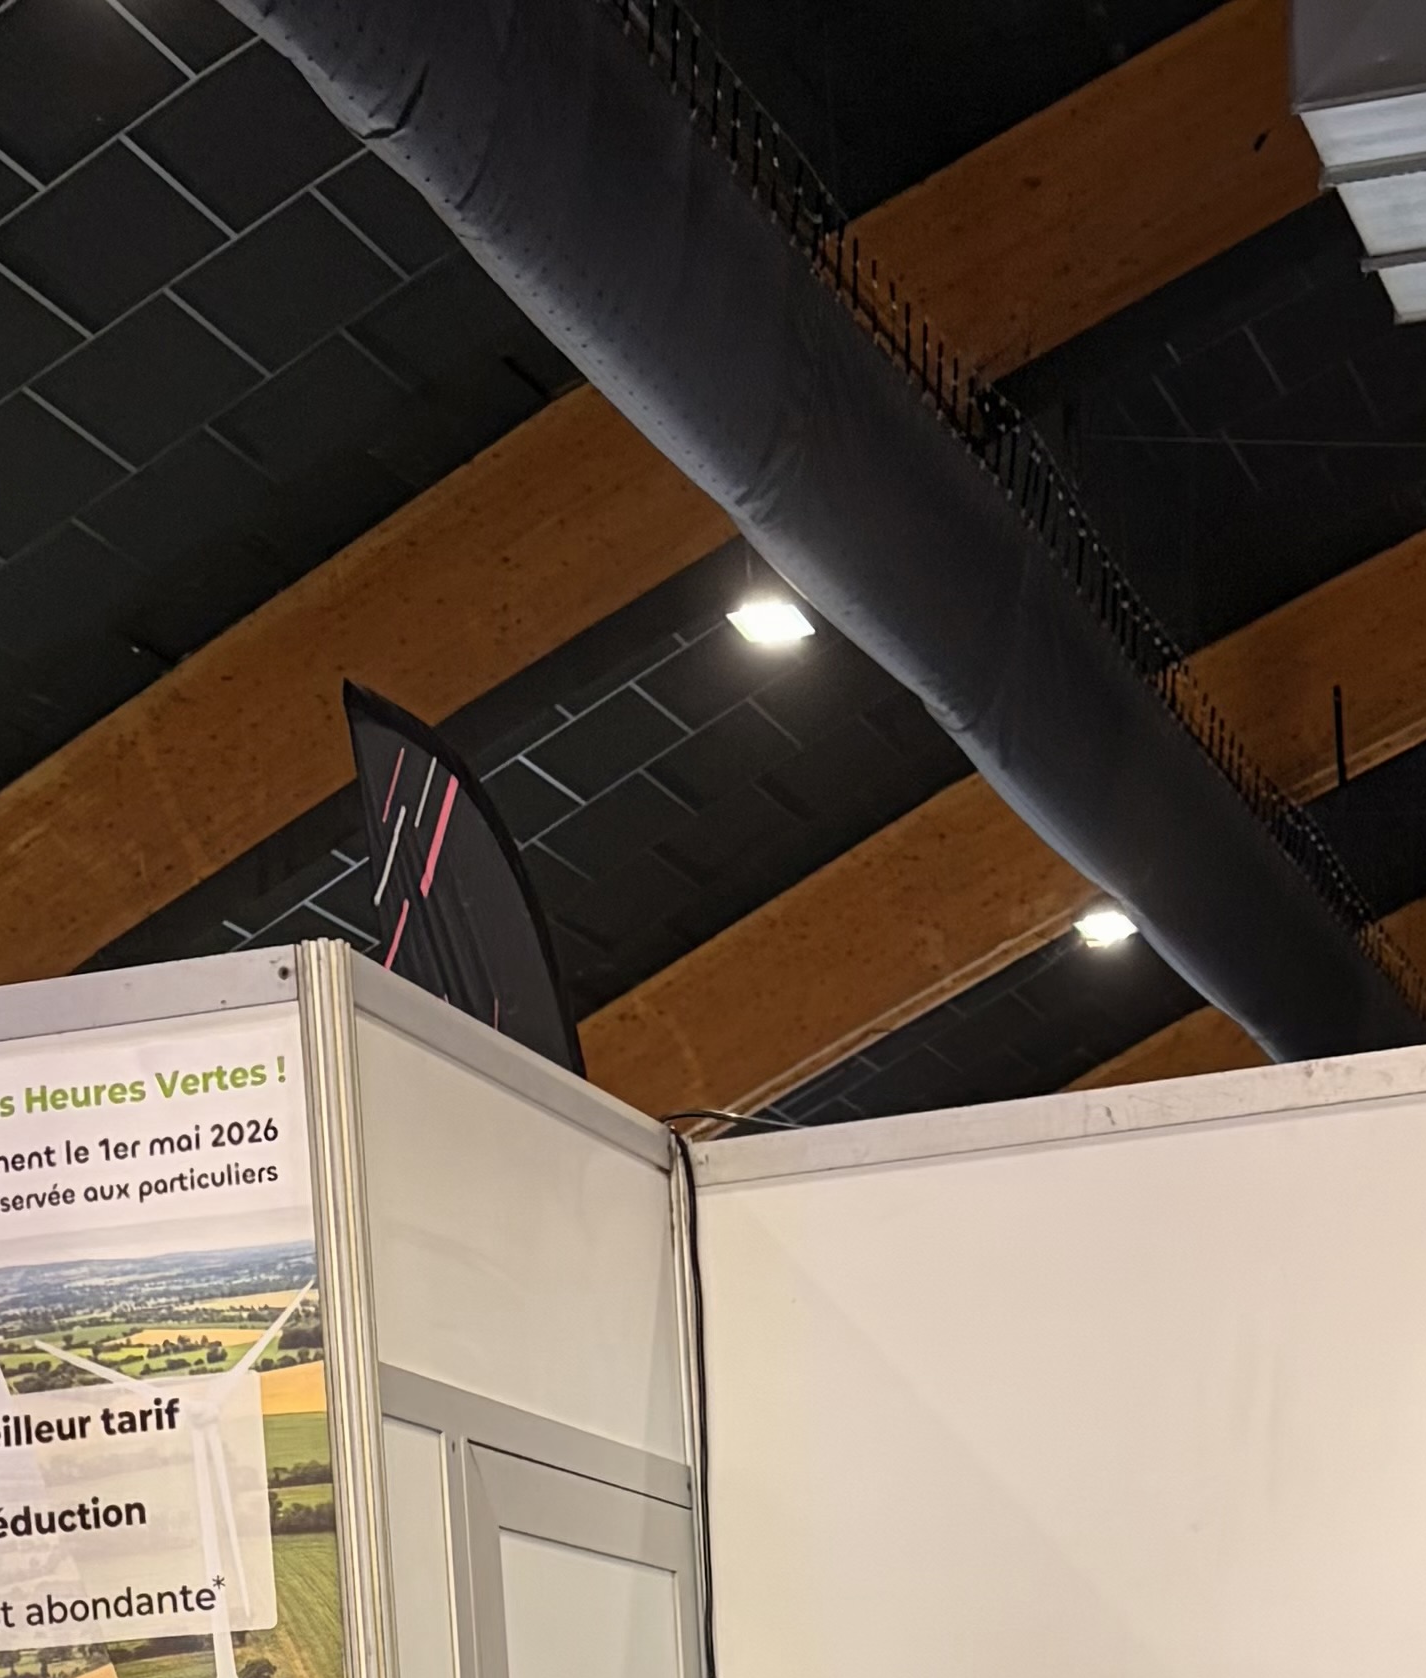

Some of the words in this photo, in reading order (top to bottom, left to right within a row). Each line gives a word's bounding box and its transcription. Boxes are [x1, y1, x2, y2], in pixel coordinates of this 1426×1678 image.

[25, 1080, 146, 1114] Heures
[154, 1064, 267, 1099] Vertes
[65, 1139, 90, 1165] le
[98, 1137, 141, 1162] 1er
[149, 1124, 201, 1157] mai
[210, 1117, 279, 1148] 2026
[83, 1182, 130, 1203] aux
[138, 1162, 279, 1204] particuliers
[100, 1397, 180, 1436] tarif
